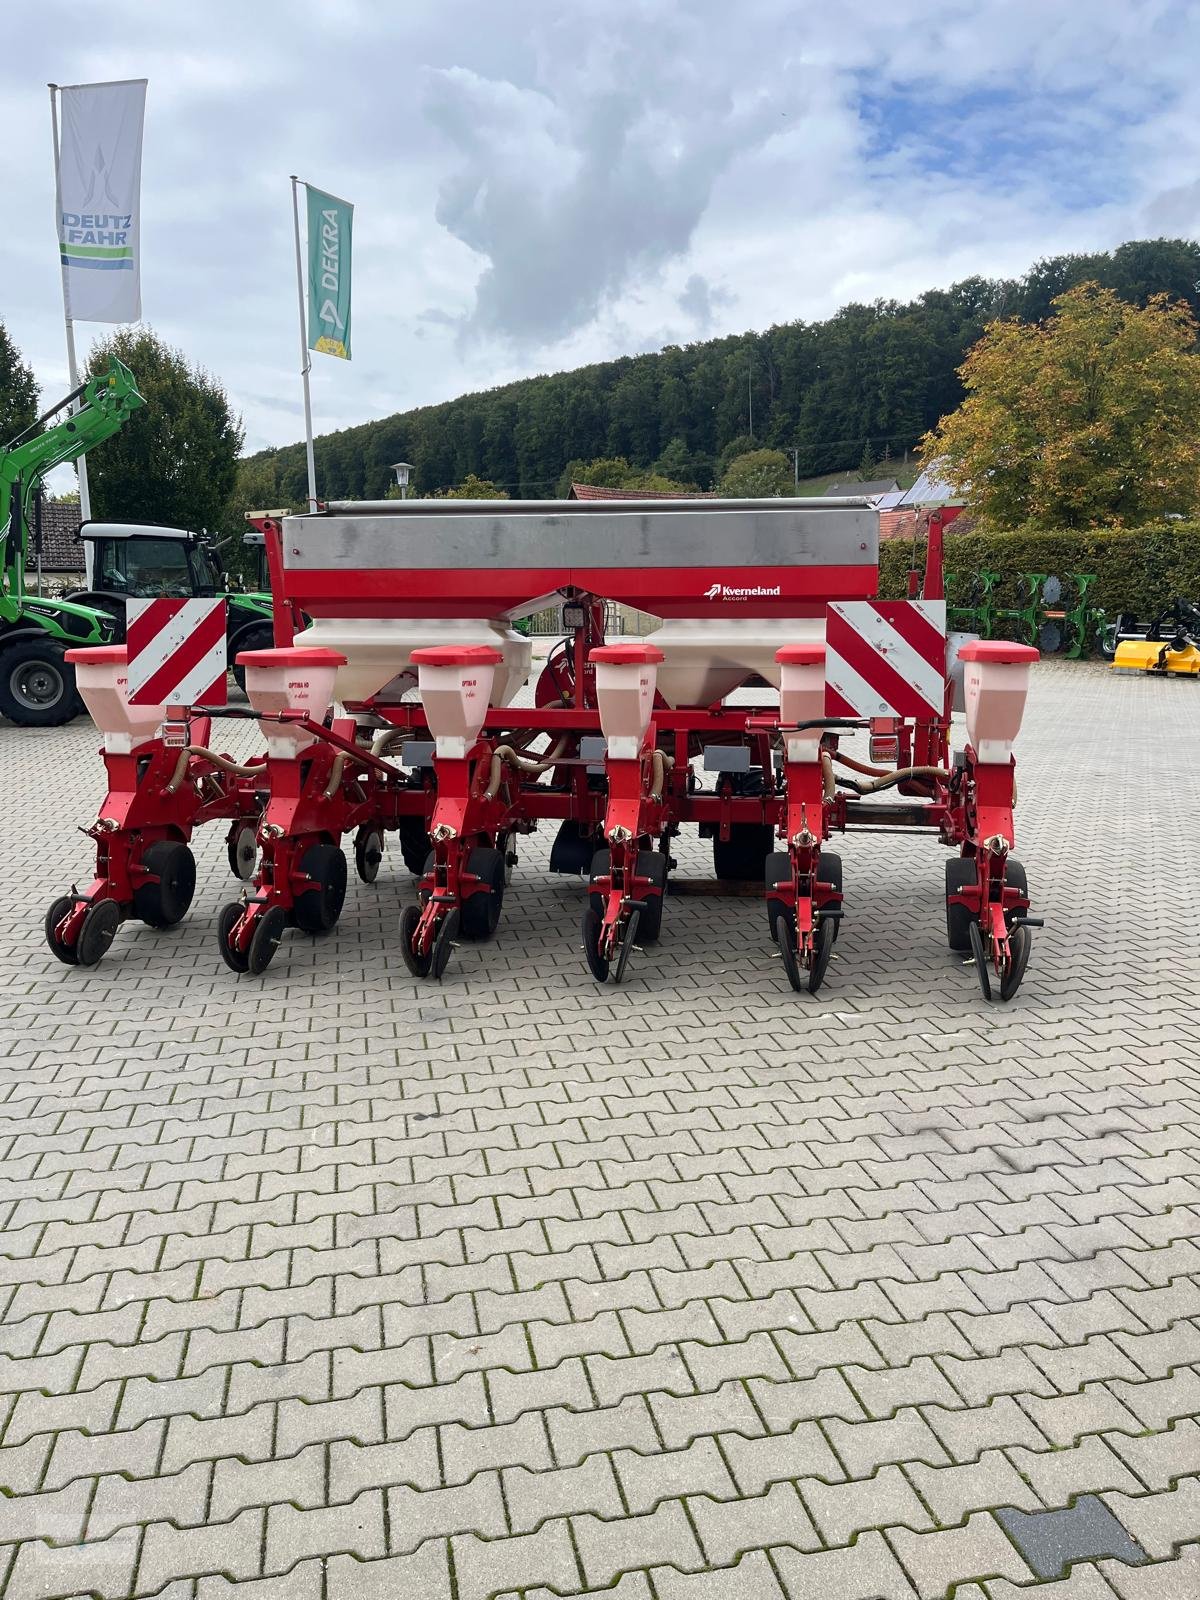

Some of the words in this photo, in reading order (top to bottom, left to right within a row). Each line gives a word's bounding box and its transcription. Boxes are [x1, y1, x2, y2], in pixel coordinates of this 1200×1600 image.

[62, 212, 132, 229] DEUTZ
[69, 230, 127, 245] FAHR
[322, 209, 338, 292] DEKRA
[722, 586, 780, 596] Kverneland
